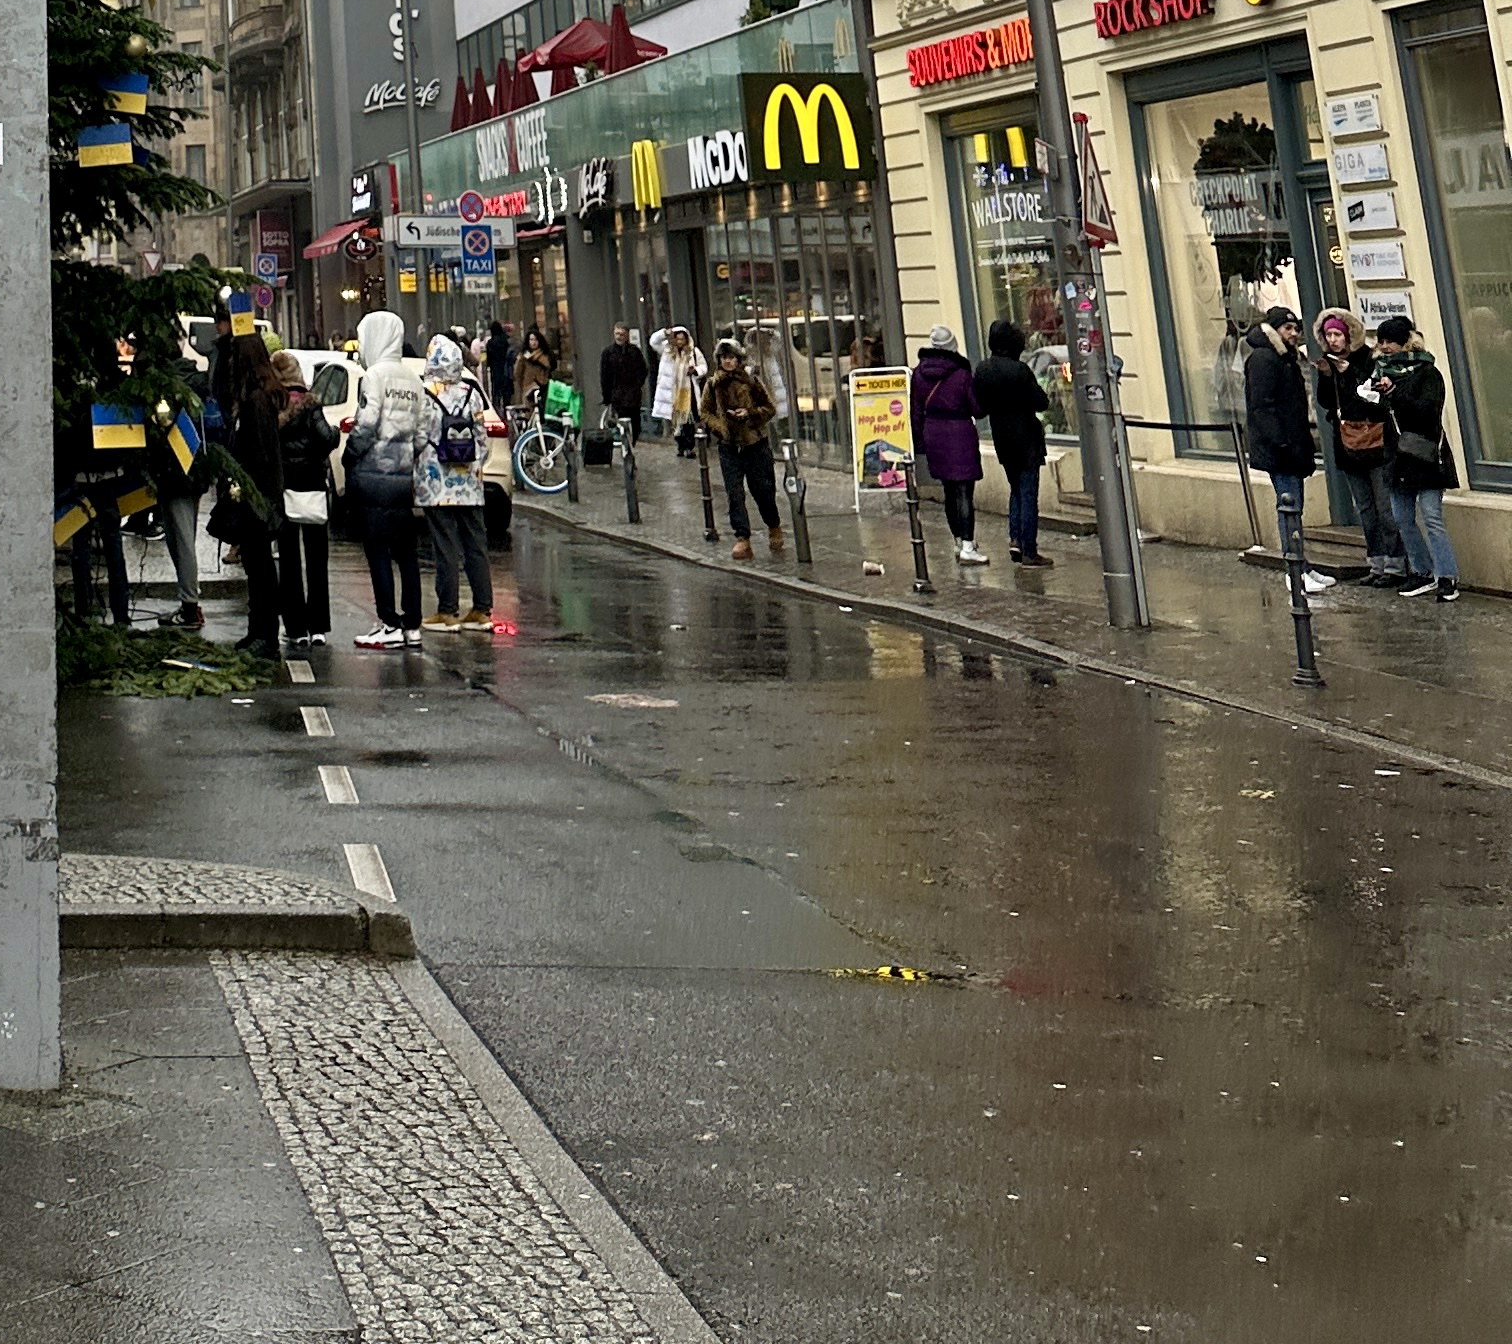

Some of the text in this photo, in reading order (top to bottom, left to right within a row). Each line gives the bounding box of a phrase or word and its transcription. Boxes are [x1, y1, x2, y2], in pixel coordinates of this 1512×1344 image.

[906, 32, 986, 88] SOUVENIRS
[987, 29, 1001, 69] &
[1188, 173, 1258, 207] CHECKPOINT
[971, 191, 1043, 230] WALLSTORE
[1202, 206, 1252, 237] CHARLIE
[465, 258, 492, 271] TAXI
[868, 379, 890, 390] TICKETS
[858, 413, 888, 426] Hop on
[873, 420, 906, 435] Hop off
